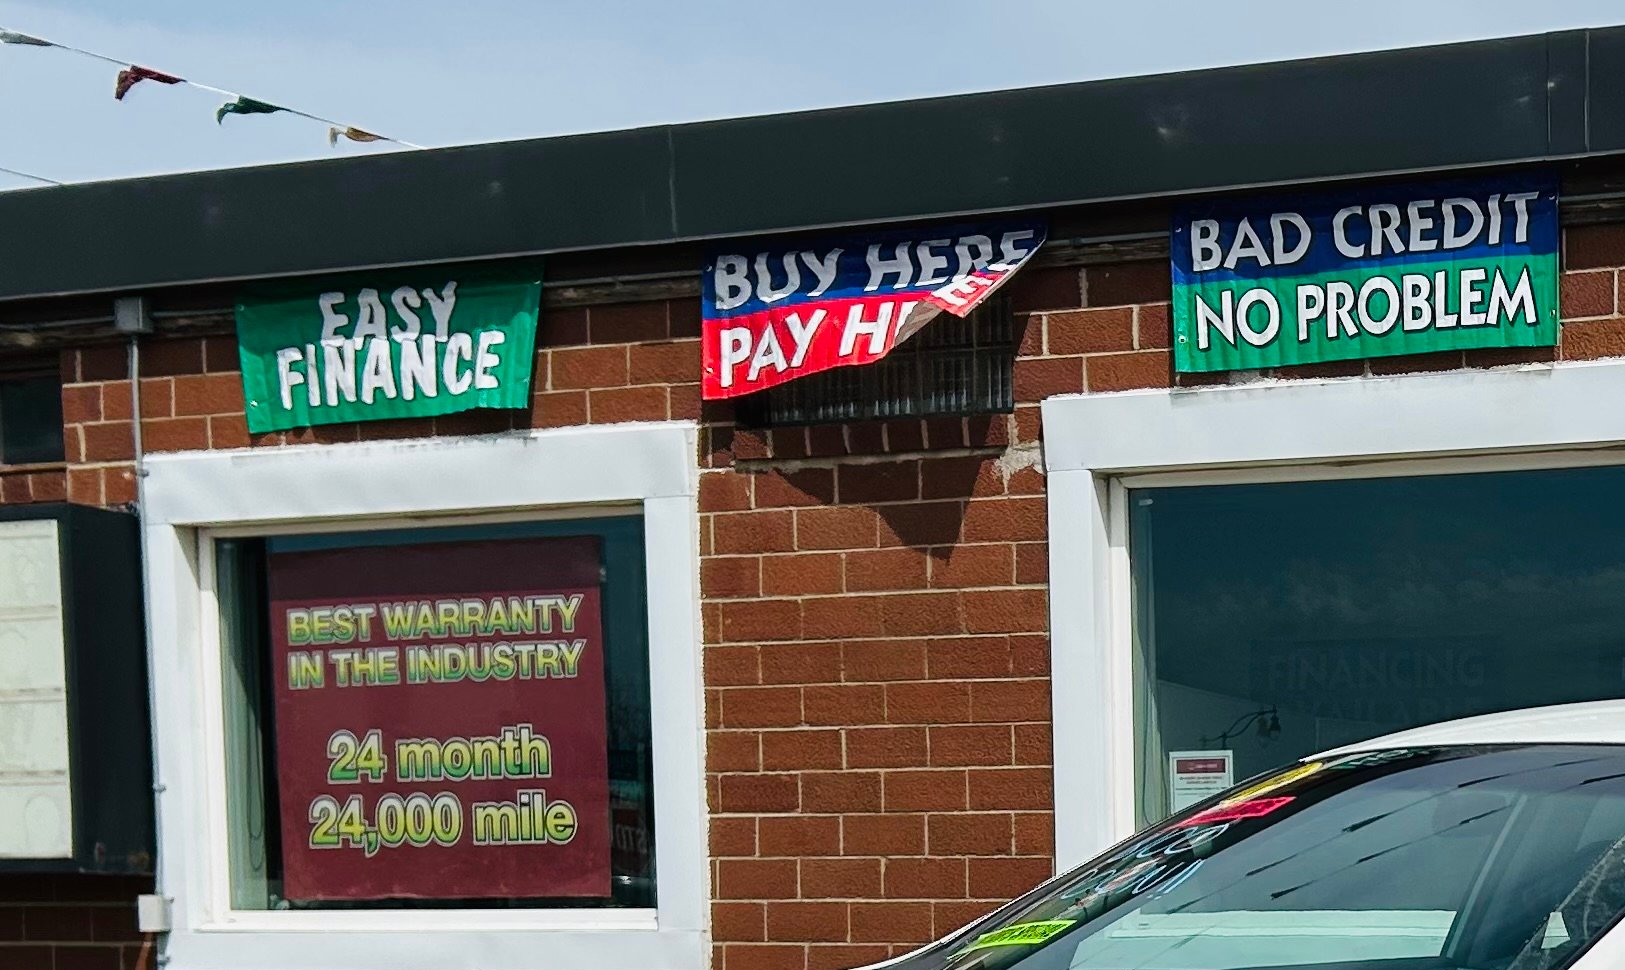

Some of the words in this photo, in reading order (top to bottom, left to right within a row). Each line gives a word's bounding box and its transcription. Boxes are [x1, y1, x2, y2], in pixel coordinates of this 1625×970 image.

[1191, 211, 1312, 272] BAD
[1333, 191, 1540, 259] CREDIT
[715, 247, 844, 310] BUY
[865, 229, 1035, 292] HERE
[318, 280, 458, 351] EASY
[1195, 288, 1281, 350] NO
[1298, 266, 1538, 341] PROBLEM
[276, 330, 506, 411] FINANCE
[720, 308, 828, 388] PAY
[286, 603, 376, 646] BEST
[382, 594, 585, 640] WARRANTY
[288, 650, 325, 690] IN
[329, 646, 401, 688] THE
[406, 638, 588, 685] INDUSTRY
[326, 728, 387, 784] 24
[395, 723, 552, 783] month
[309, 792, 463, 858] 24,000
[472, 788, 579, 846] mile
